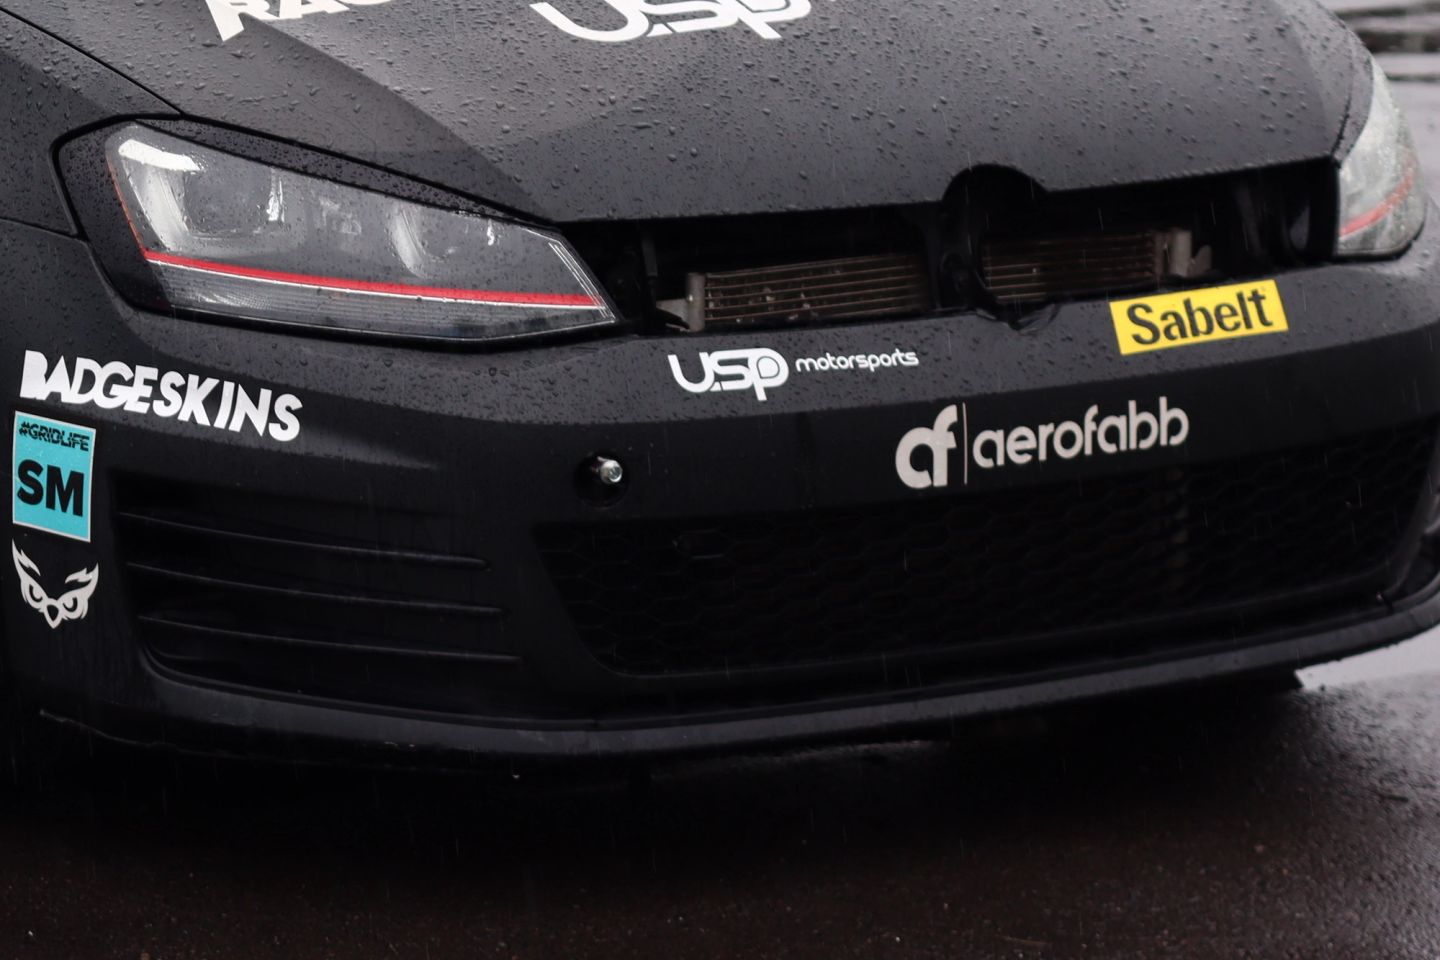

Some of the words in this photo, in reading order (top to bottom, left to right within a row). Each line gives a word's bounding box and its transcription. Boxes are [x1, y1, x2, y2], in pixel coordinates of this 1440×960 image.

[1126, 287, 1273, 346] Sabelt
[795, 348, 919, 372] motorsports
[19, 350, 303, 441] BADGESKINS
[18, 421, 89, 452] #GRIDLIFE
[973, 396, 1190, 471] aerofabb
[16, 458, 84, 518] SM
